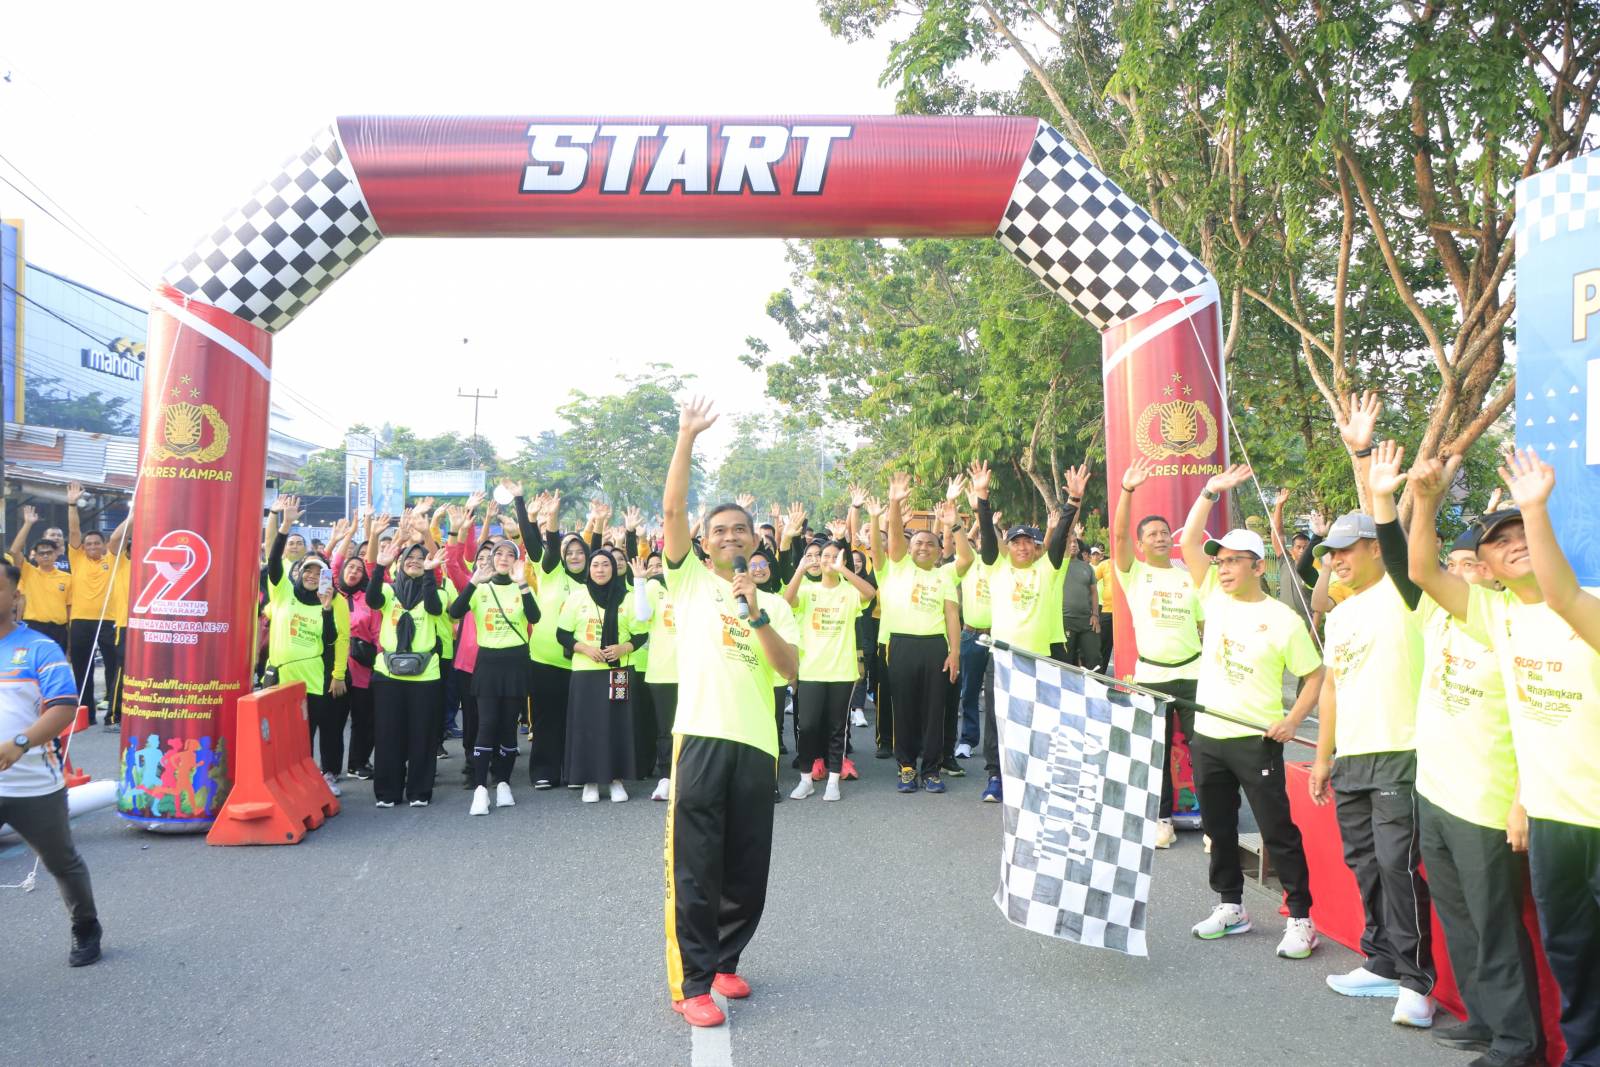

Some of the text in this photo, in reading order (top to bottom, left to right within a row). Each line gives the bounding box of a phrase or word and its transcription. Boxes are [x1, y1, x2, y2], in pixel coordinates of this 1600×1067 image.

[519, 123, 852, 195] START
[141, 466, 232, 481] POLRES KAMPAR
[1146, 464, 1223, 476] LRES KAMPAR
[144, 632, 197, 644] TAHUN 2025
[1546, 661, 1563, 673] TO
[1527, 684, 1583, 700] Bhayangkara
[1544, 702, 1572, 713] 2025
